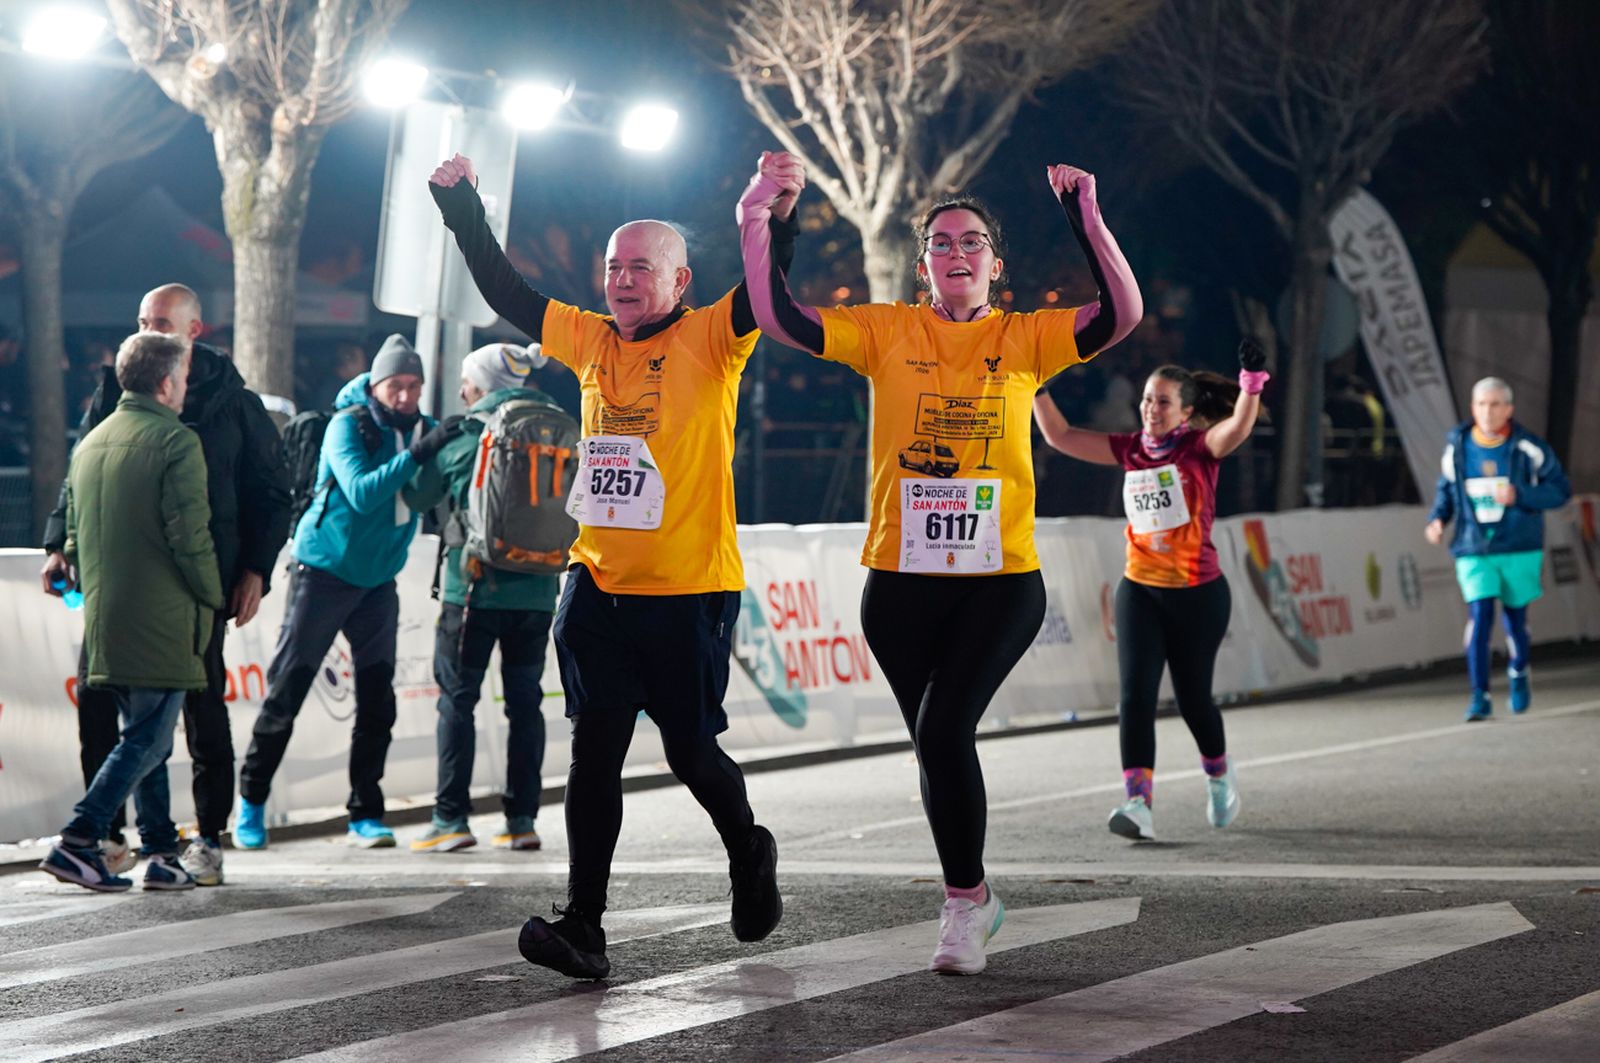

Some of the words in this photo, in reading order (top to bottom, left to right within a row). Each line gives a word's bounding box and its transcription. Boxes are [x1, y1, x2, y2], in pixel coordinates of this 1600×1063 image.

[1363, 218, 1443, 389] JAPEMASA
[588, 456, 600, 467] SAN
[595, 445, 619, 455] NOCHE
[620, 446, 631, 456] DE
[590, 468, 647, 497] 5257
[924, 489, 954, 499] NOCHE
[955, 489, 968, 499] DE
[912, 500, 932, 511] SAN
[933, 498, 968, 511] ANTÓN
[1133, 489, 1173, 512] 5253
[925, 512, 979, 541] 6117
[767, 580, 819, 630] SAN
[784, 618, 873, 690] ANTÓN
